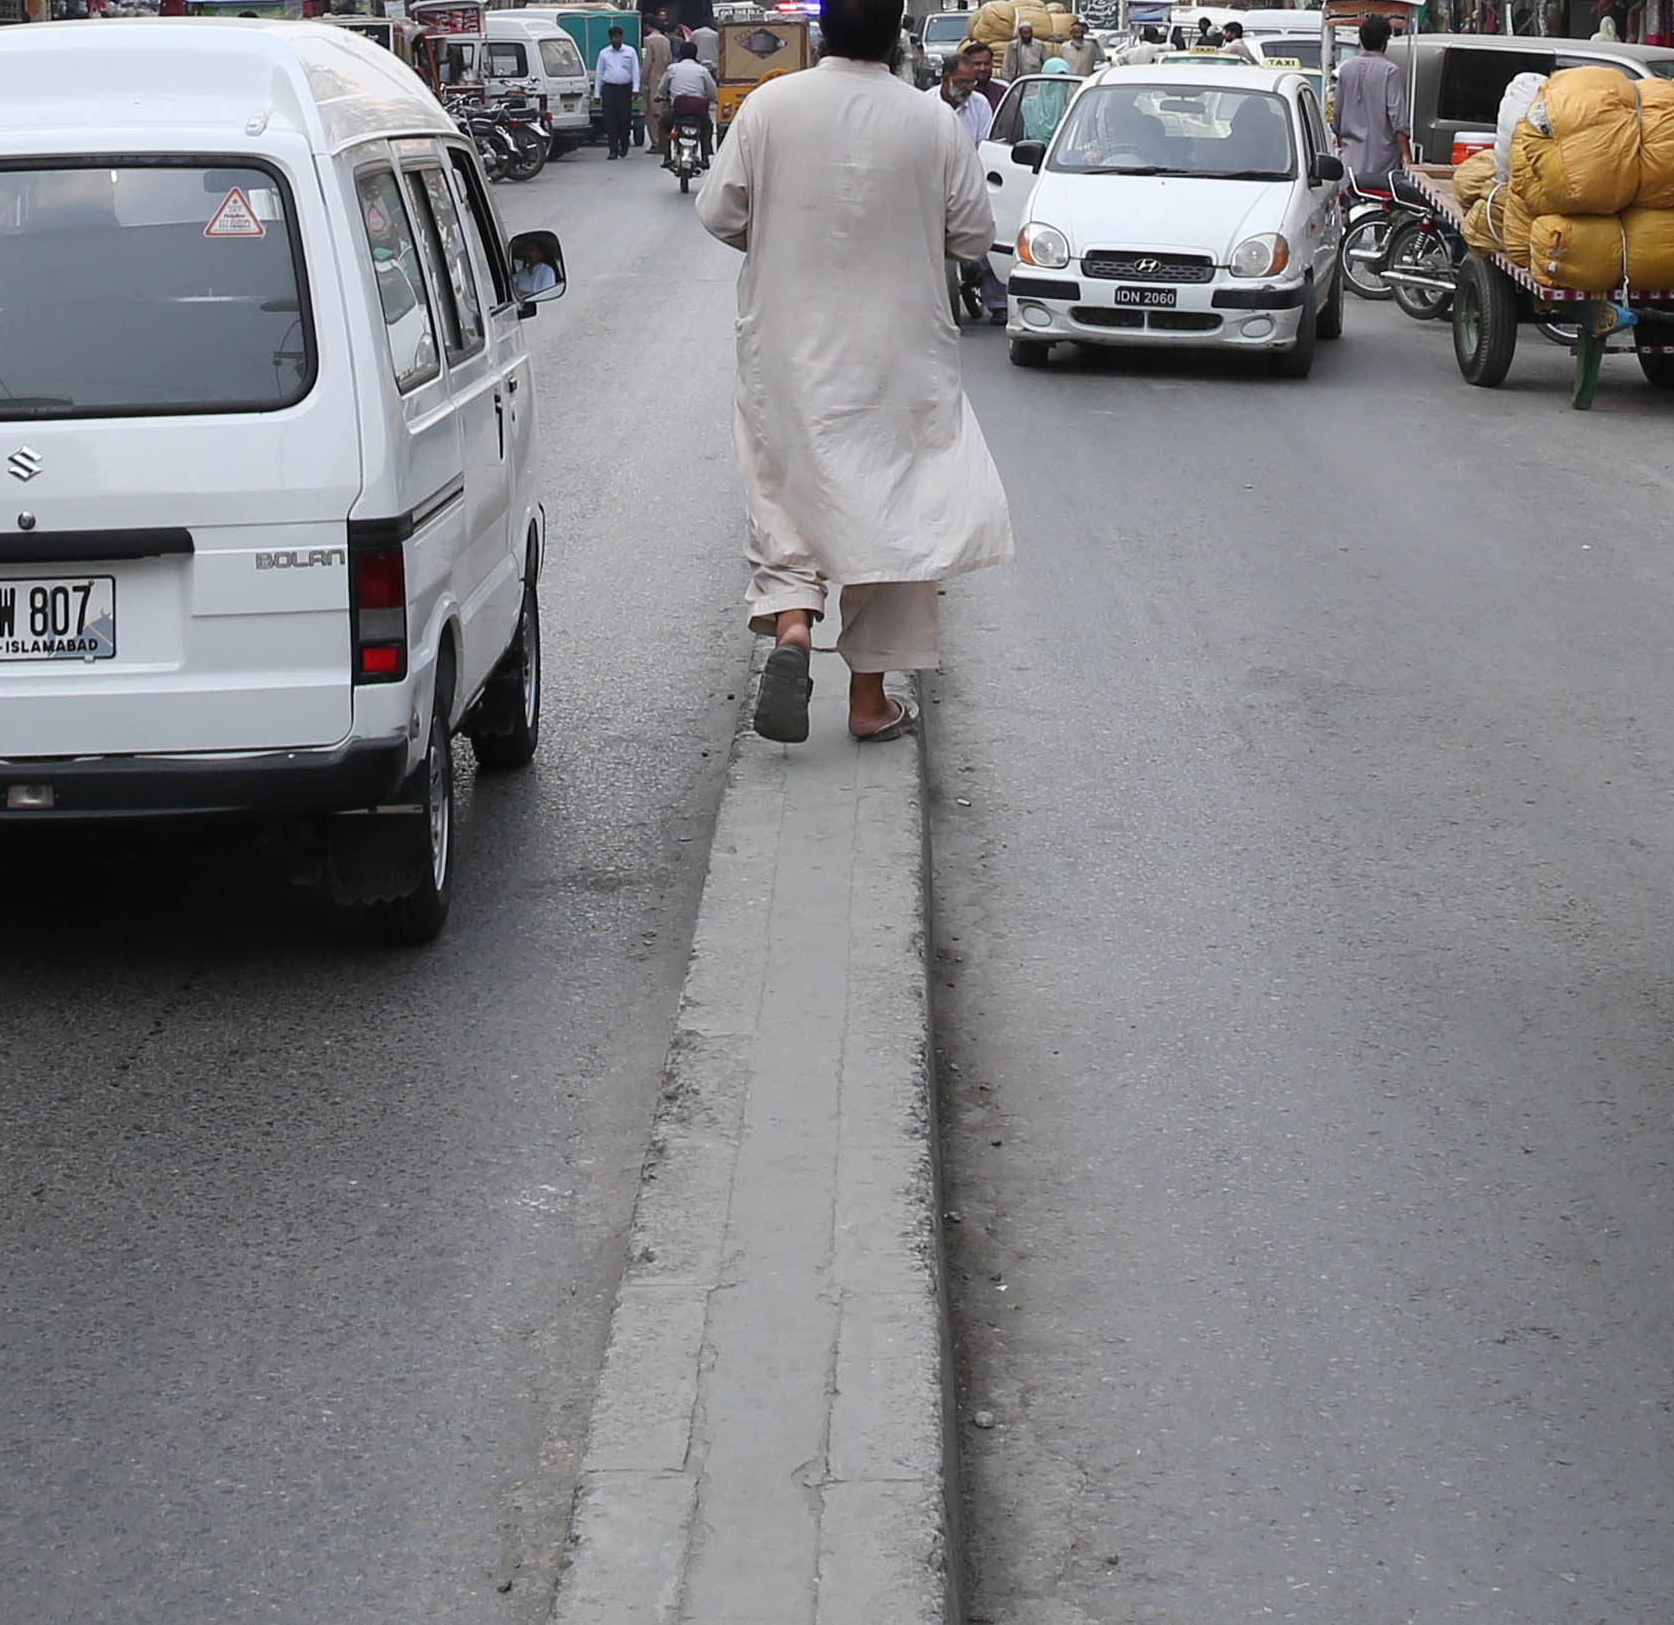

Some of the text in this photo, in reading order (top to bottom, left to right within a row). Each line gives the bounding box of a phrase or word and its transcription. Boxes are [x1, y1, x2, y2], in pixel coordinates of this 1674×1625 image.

[1268, 58, 1296, 66] TAXI
[1116, 288, 1175, 306] IDN 2060
[255, 550, 346, 570] BOLAN
[28, 586, 92, 638] 807
